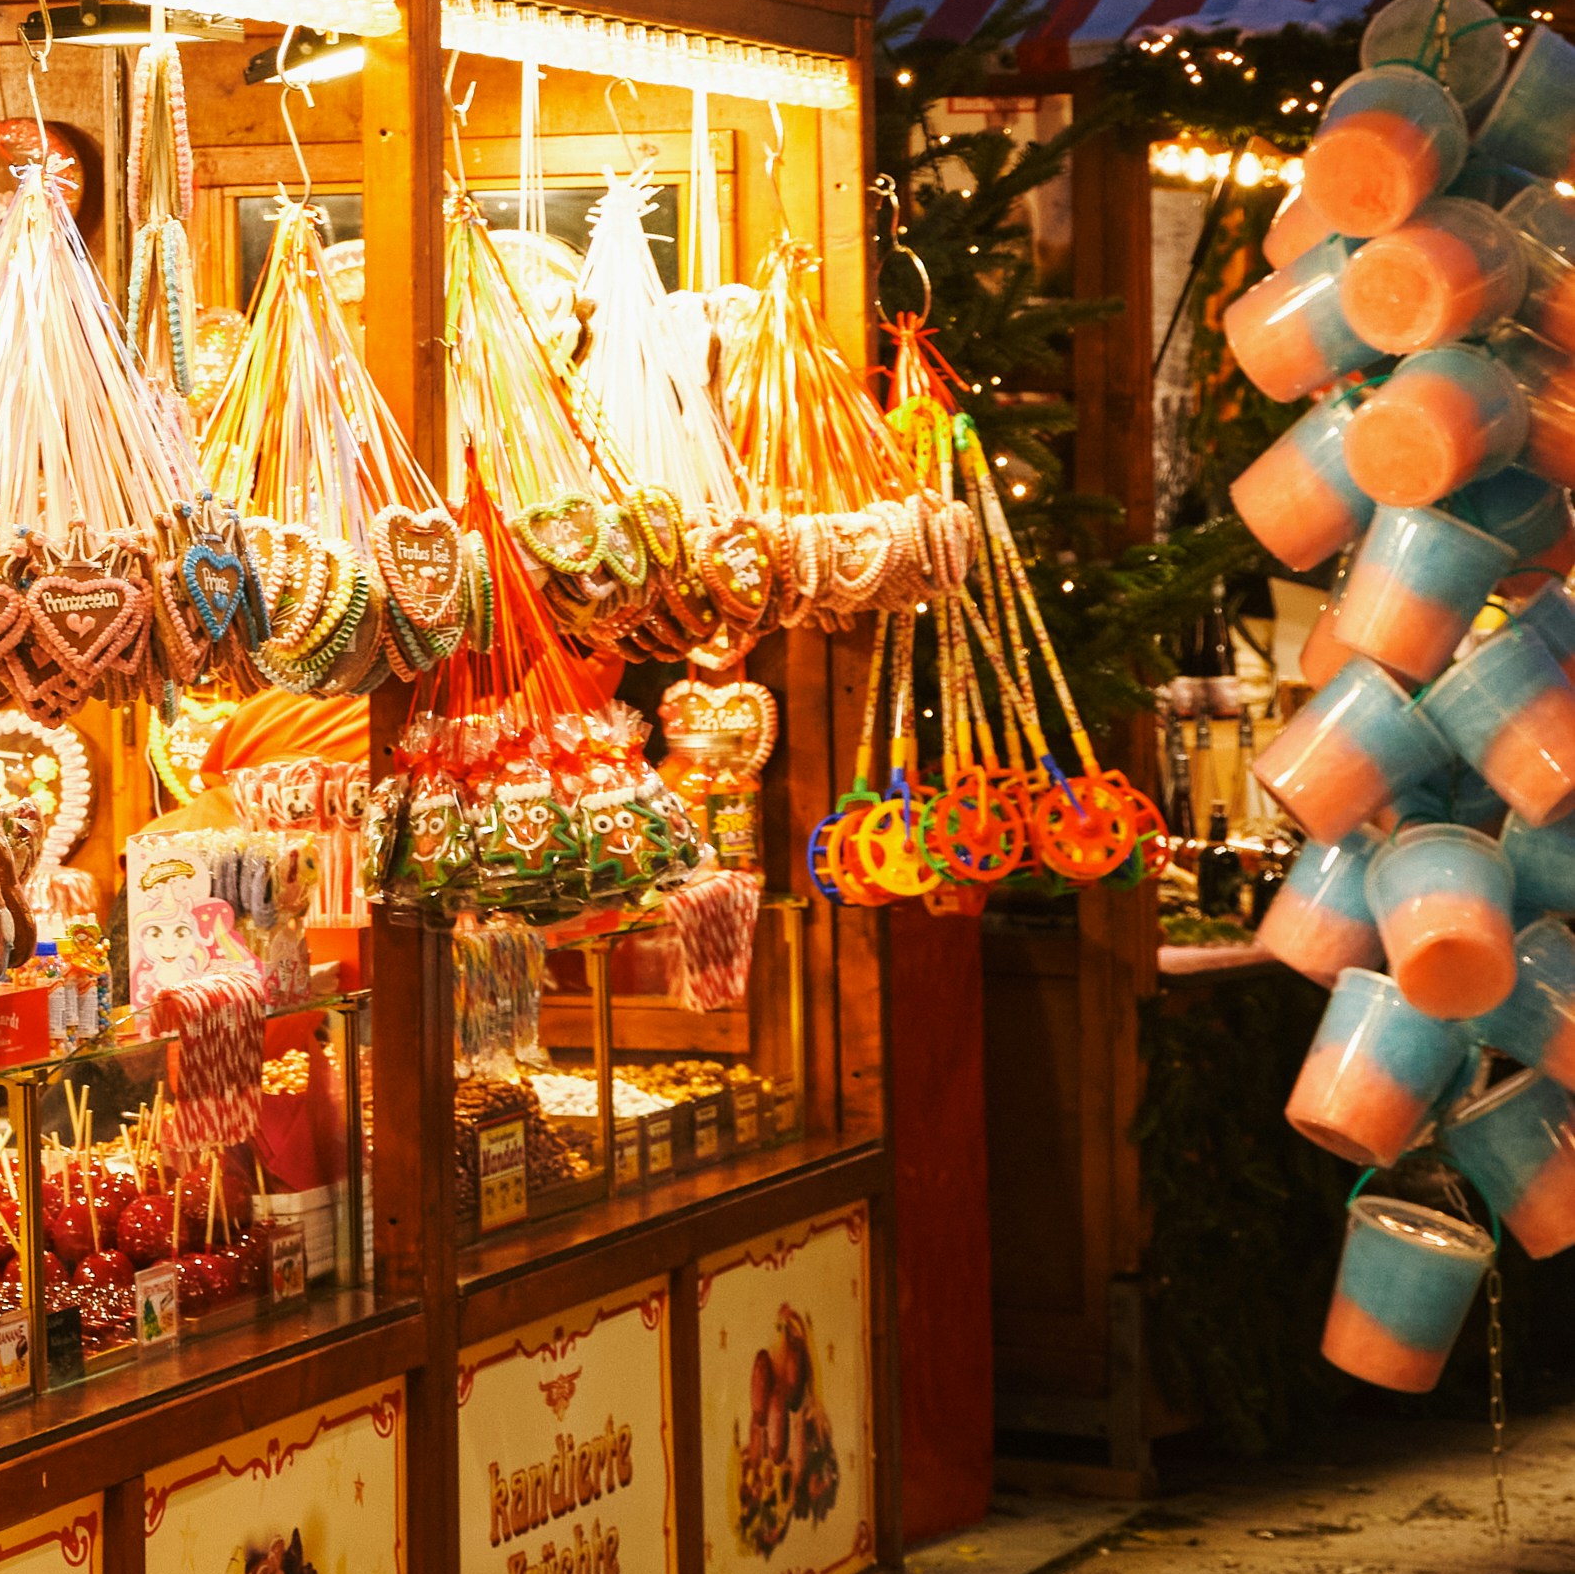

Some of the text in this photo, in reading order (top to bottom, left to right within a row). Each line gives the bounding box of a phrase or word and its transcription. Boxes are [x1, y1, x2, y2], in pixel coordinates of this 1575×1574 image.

[201, 567, 231, 594] Prinz
[43, 590, 120, 614] Prinzessin
[488, 1413, 634, 1548] kandierte
